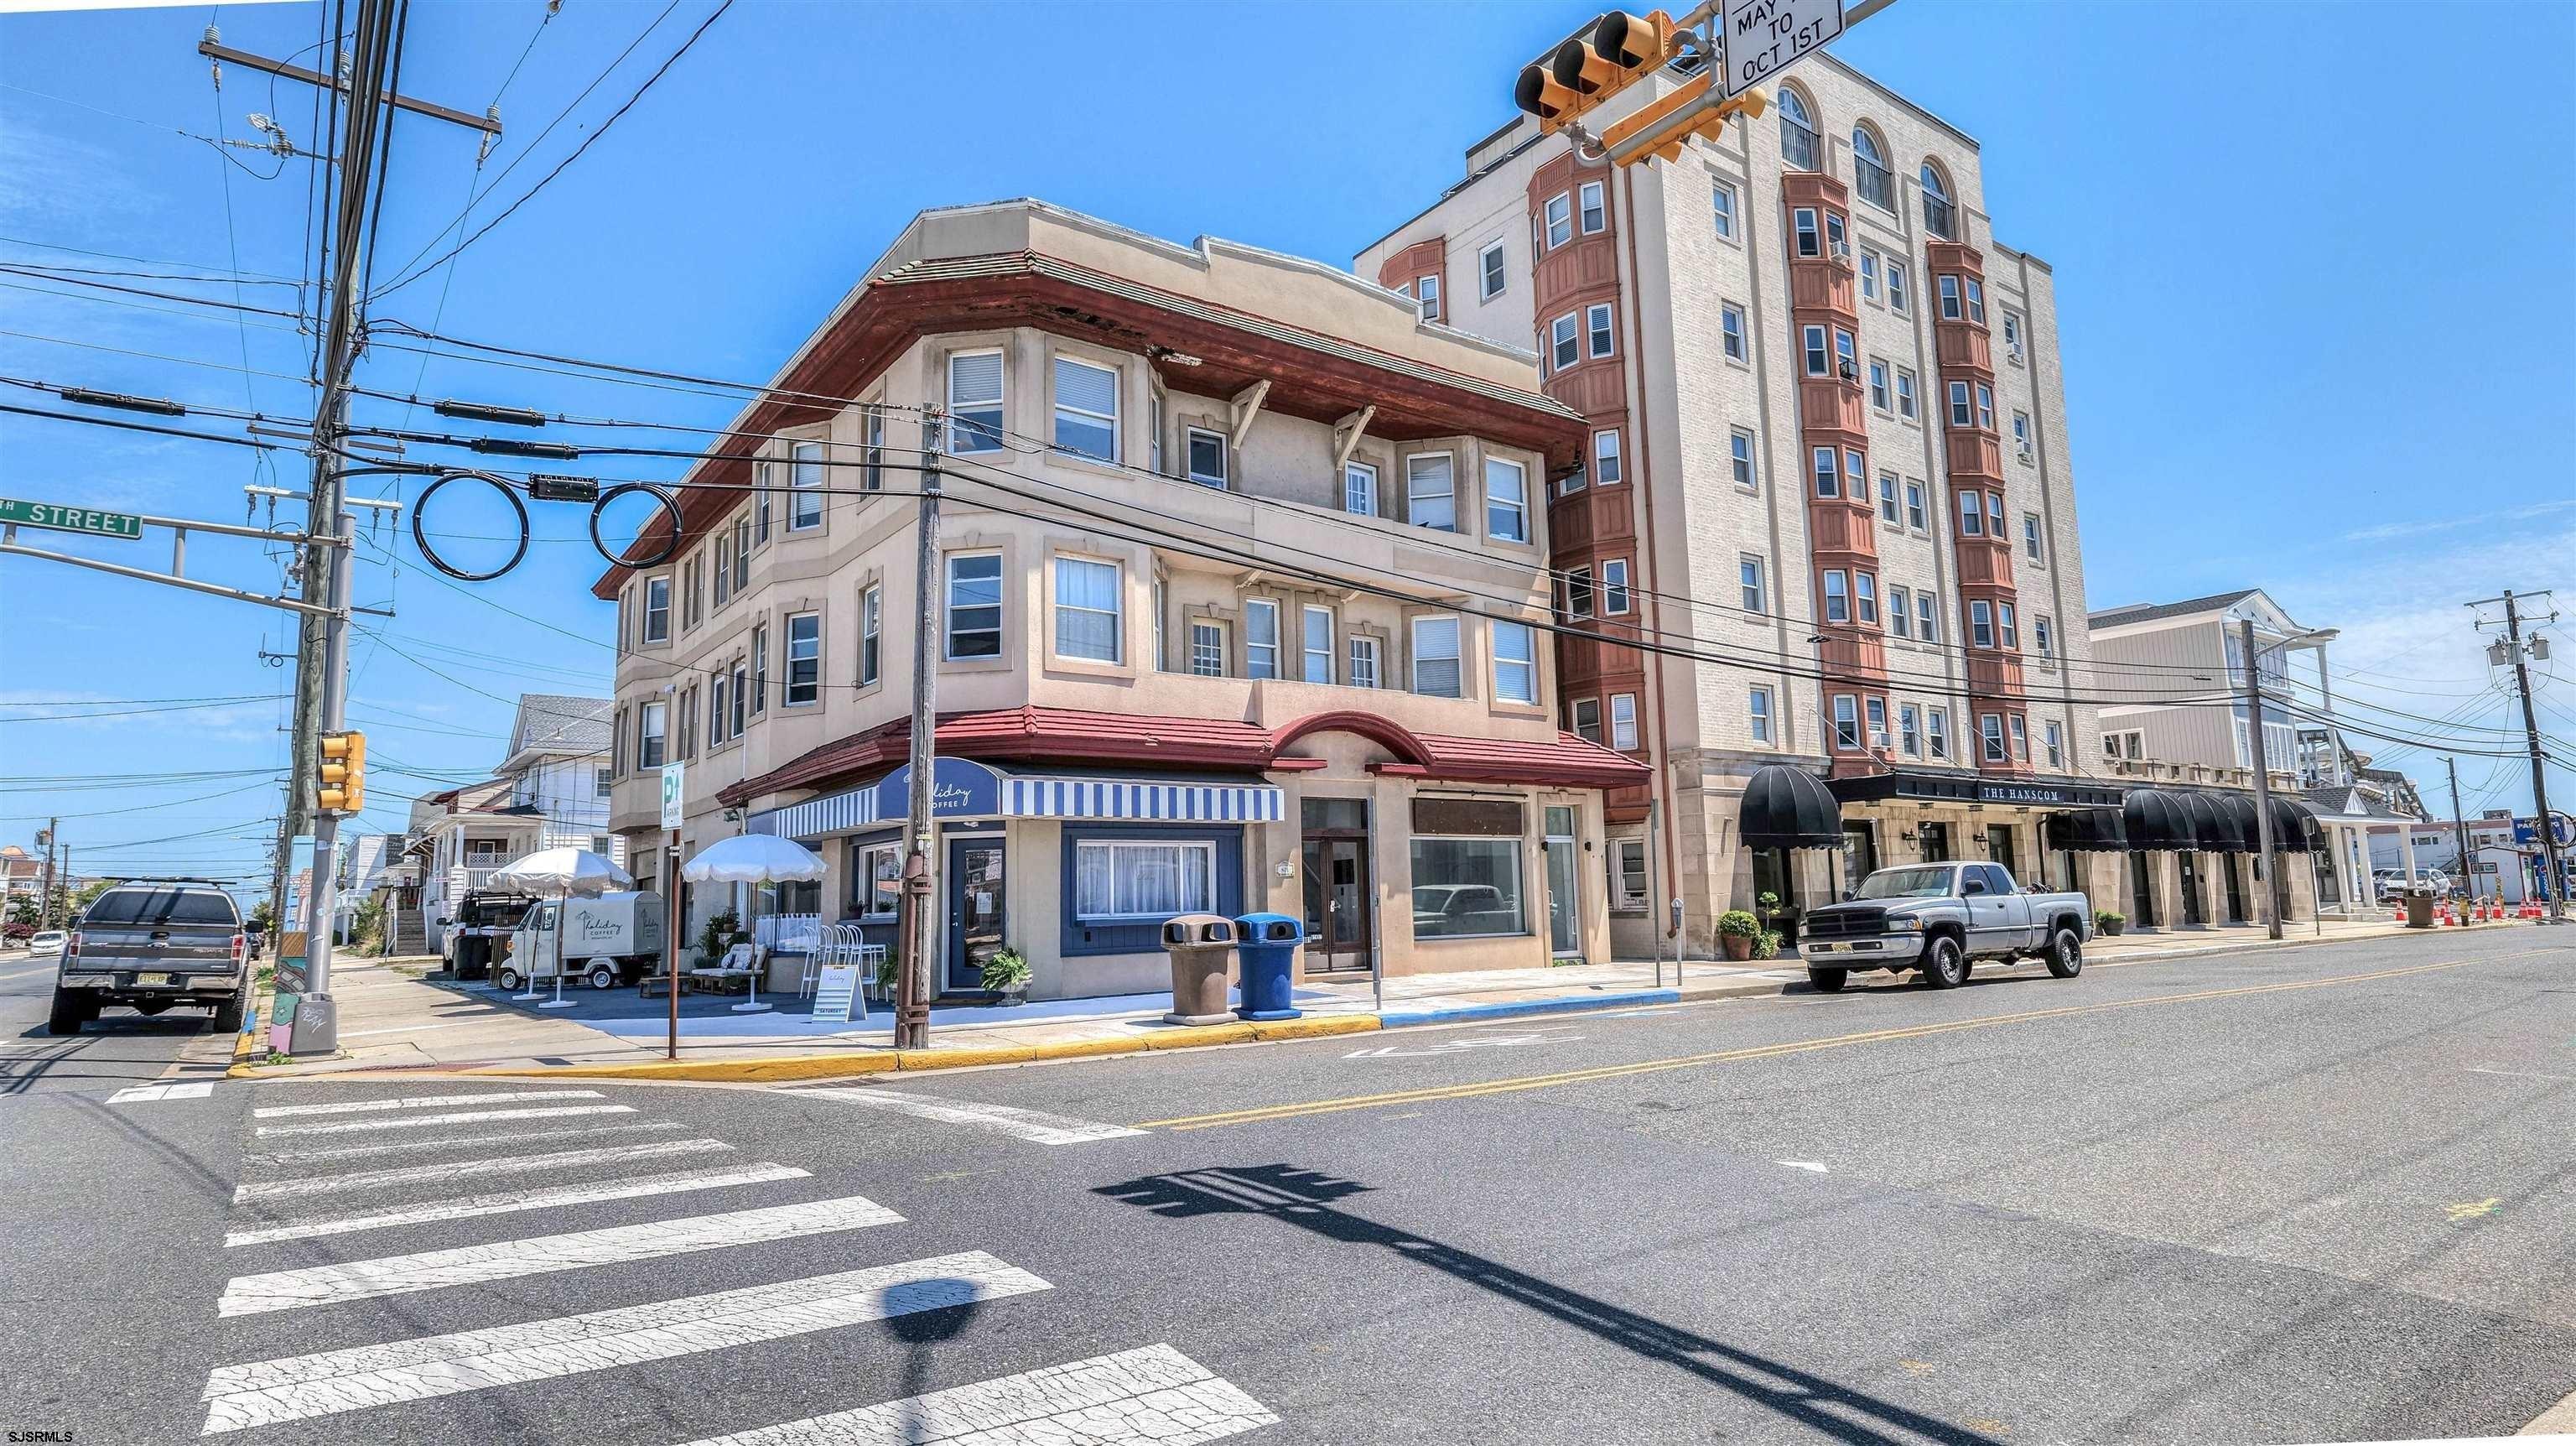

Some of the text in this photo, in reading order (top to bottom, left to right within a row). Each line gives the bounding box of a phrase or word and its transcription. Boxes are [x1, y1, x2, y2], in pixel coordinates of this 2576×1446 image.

[1737, 0, 1776, 36] MAY
[1768, 13, 1793, 40] TO
[1742, 18, 1823, 81] OCT 1ST
[29, 505, 135, 533] STREET
[932, 800, 958, 809] OFFEE
[933, 783, 972, 807] liday
[1984, 788, 2058, 801] THE HANSCOM
[585, 918, 623, 935] holiday
